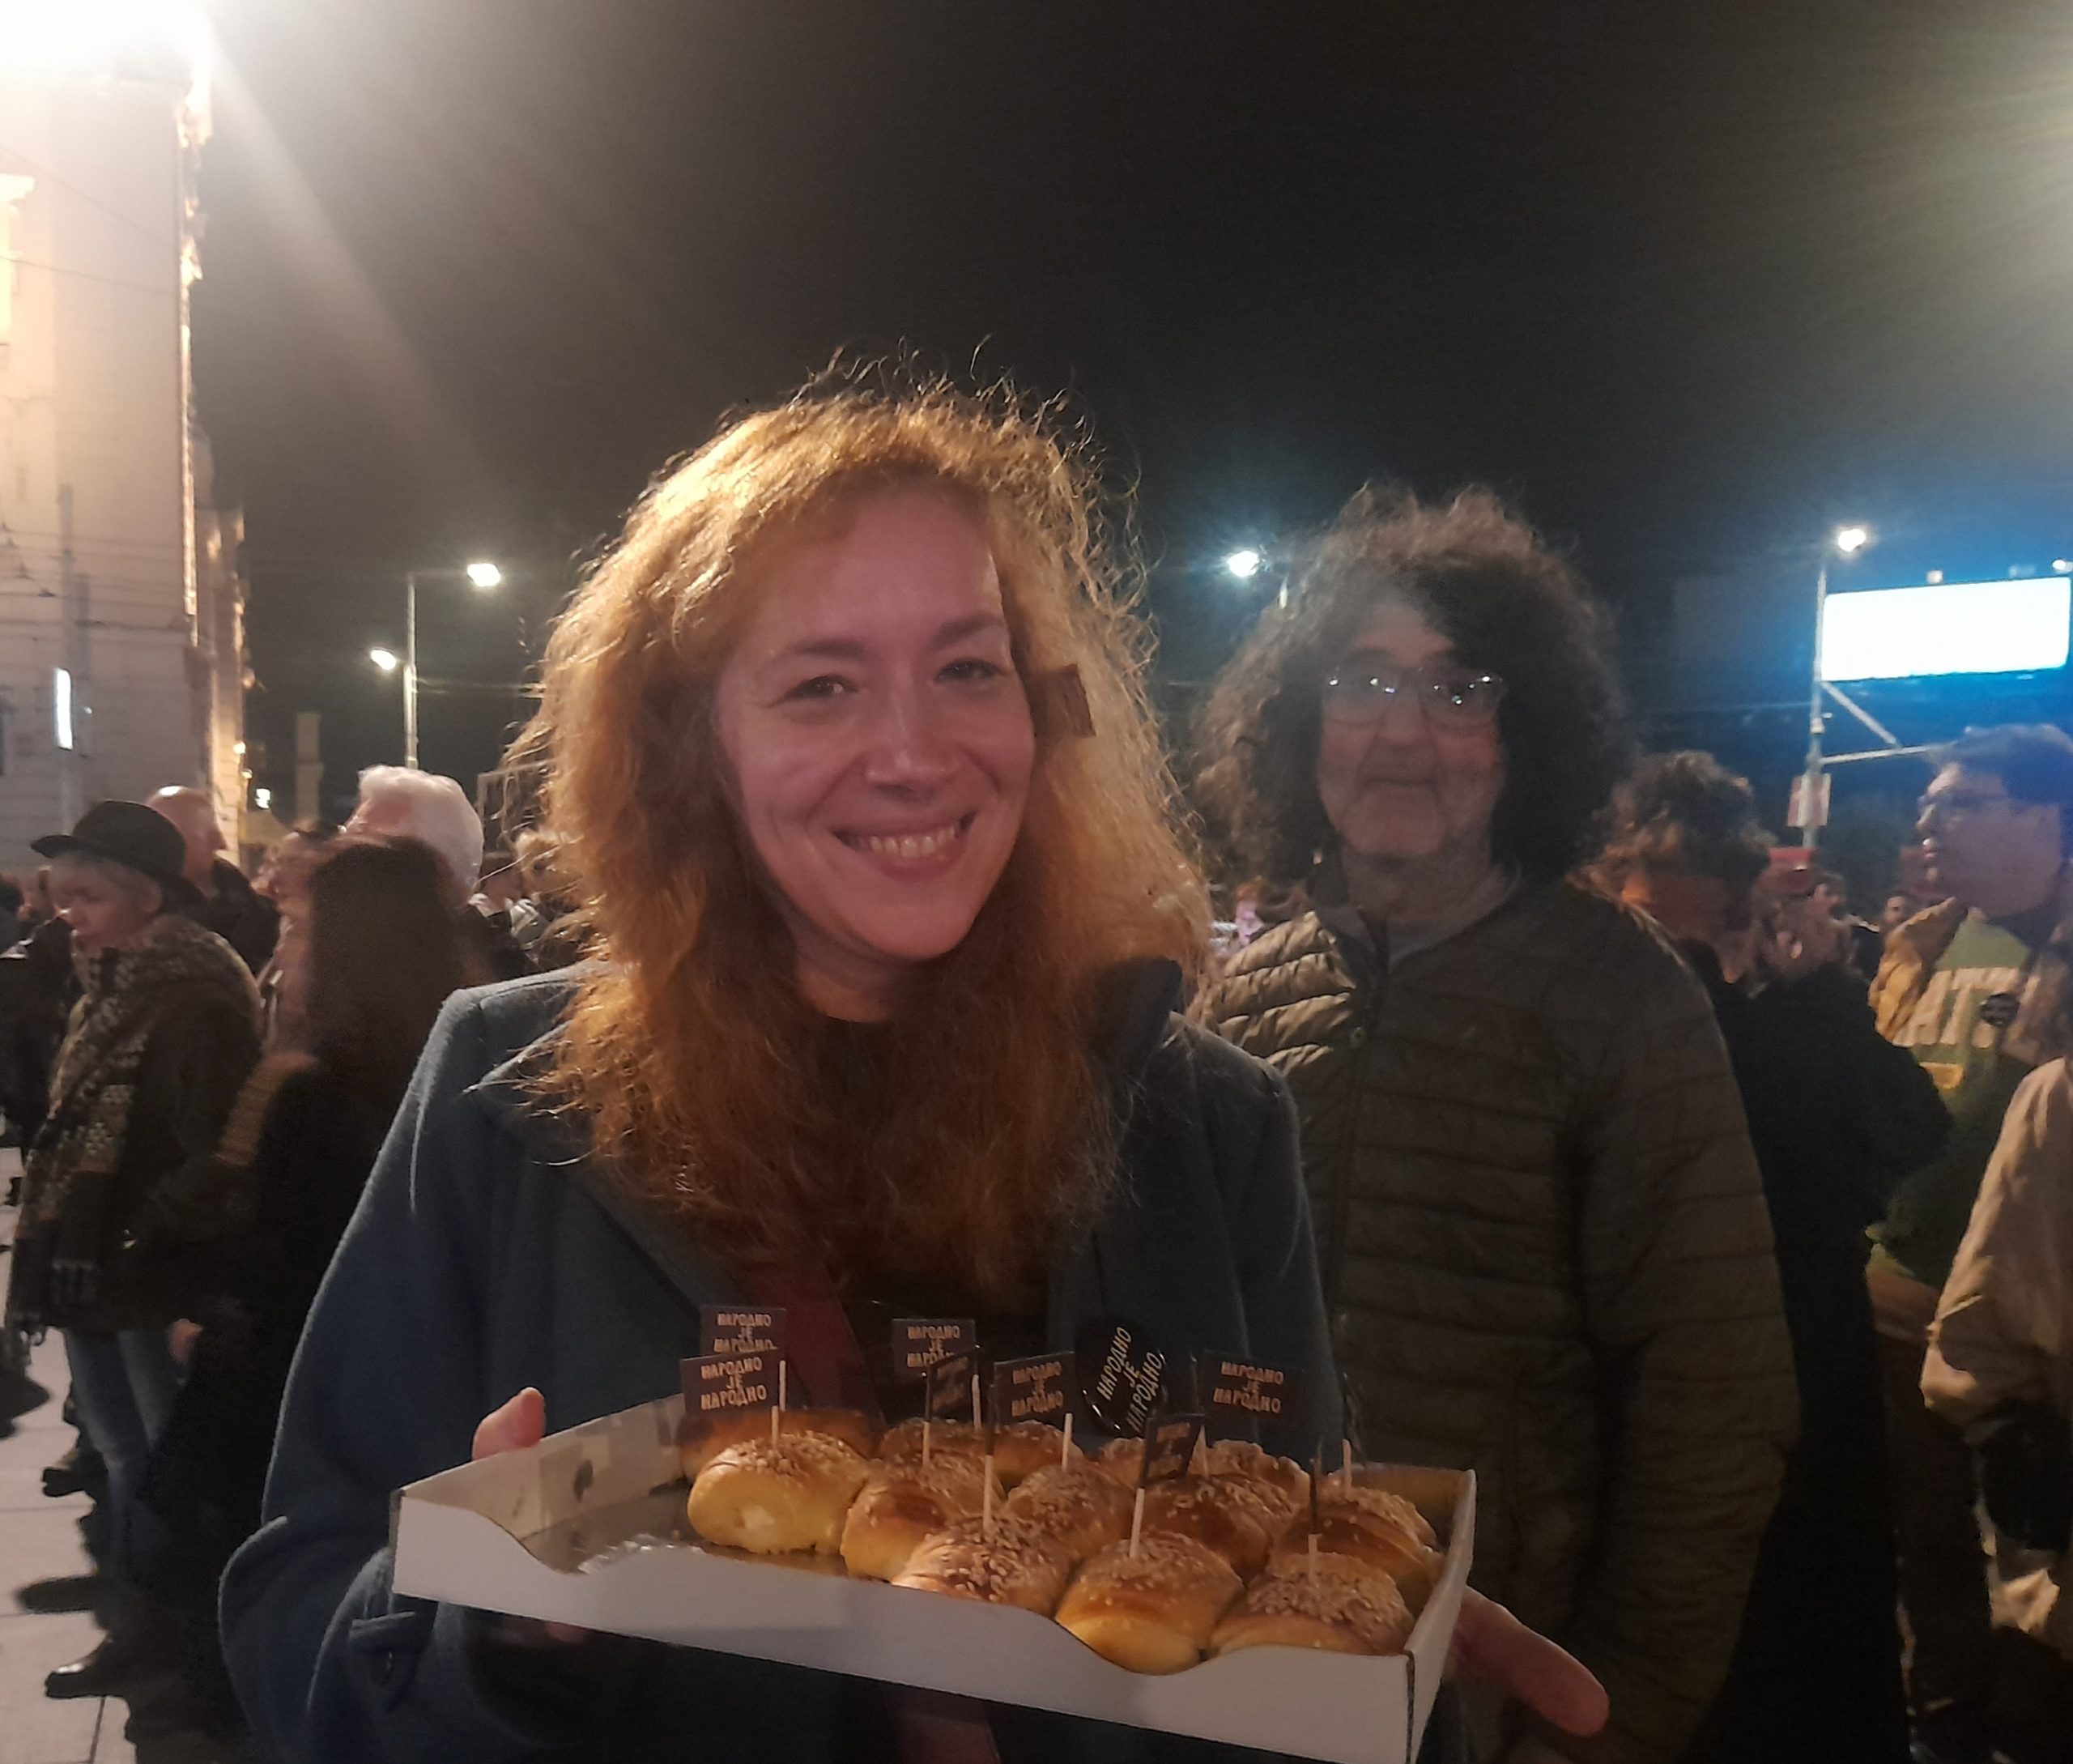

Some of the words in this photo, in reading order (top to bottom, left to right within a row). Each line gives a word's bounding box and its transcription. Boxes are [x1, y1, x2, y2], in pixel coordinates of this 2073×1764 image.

[1096, 1327, 1132, 1400] НАРОДНО
[1123, 1361, 1140, 1388] ЈЕ
[700, 1384, 767, 1410] НАРОДНО
[1126, 1352, 1162, 1433] НАРОДНО
